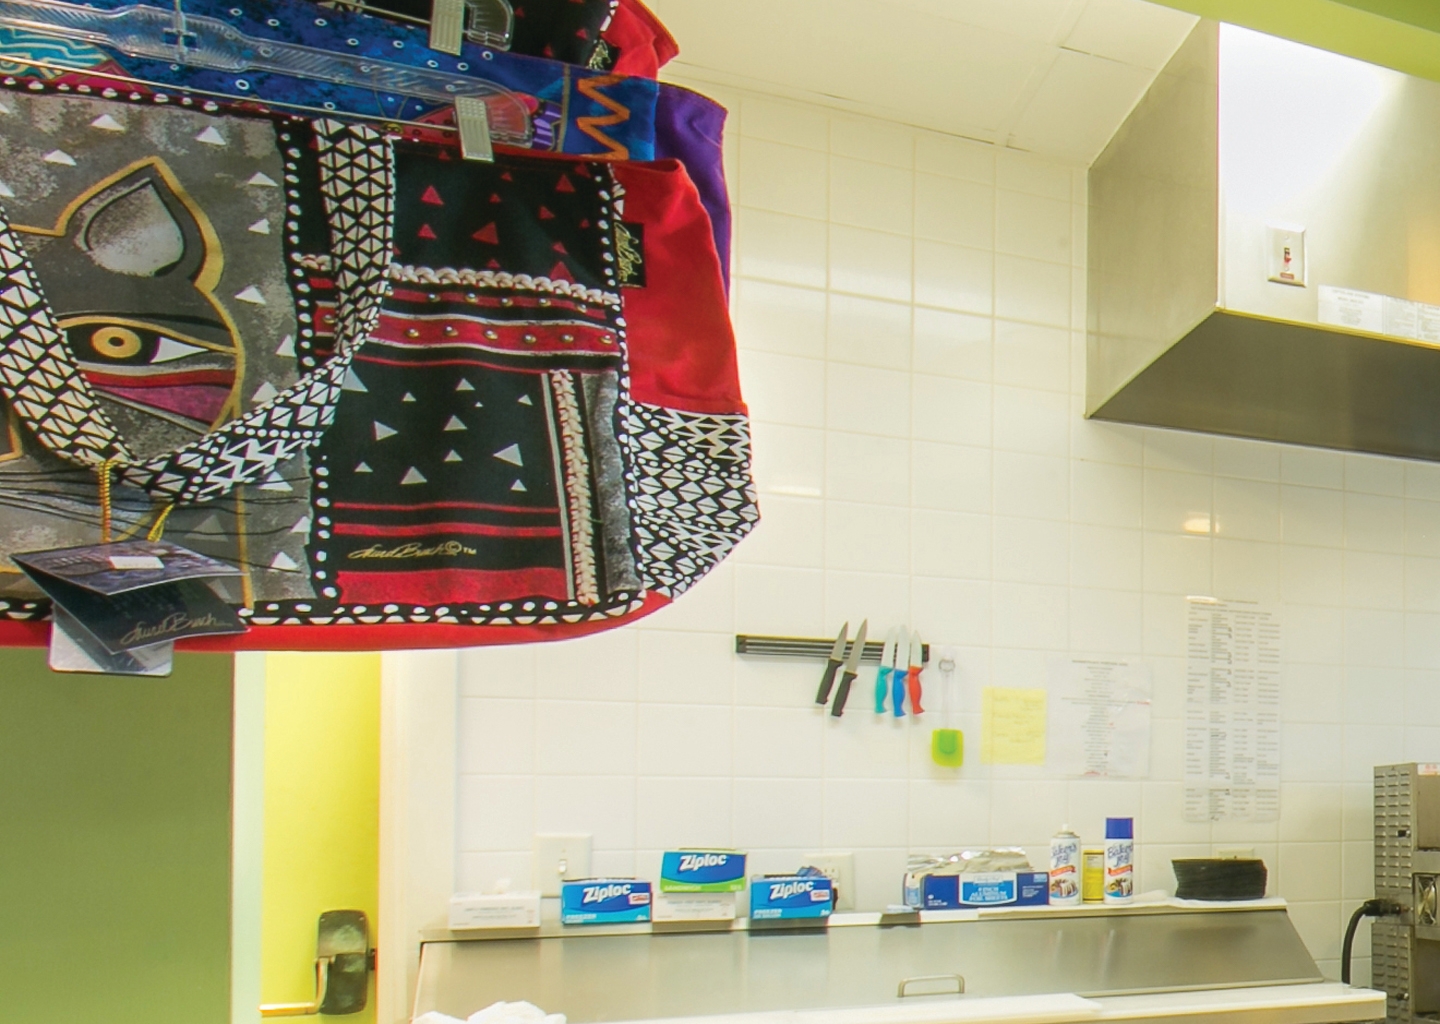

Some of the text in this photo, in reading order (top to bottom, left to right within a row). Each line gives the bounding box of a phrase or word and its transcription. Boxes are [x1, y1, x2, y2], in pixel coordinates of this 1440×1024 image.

[680, 854, 728, 871] Ziploc
[583, 883, 632, 904] Ziploc
[770, 881, 815, 901] Ziploc
